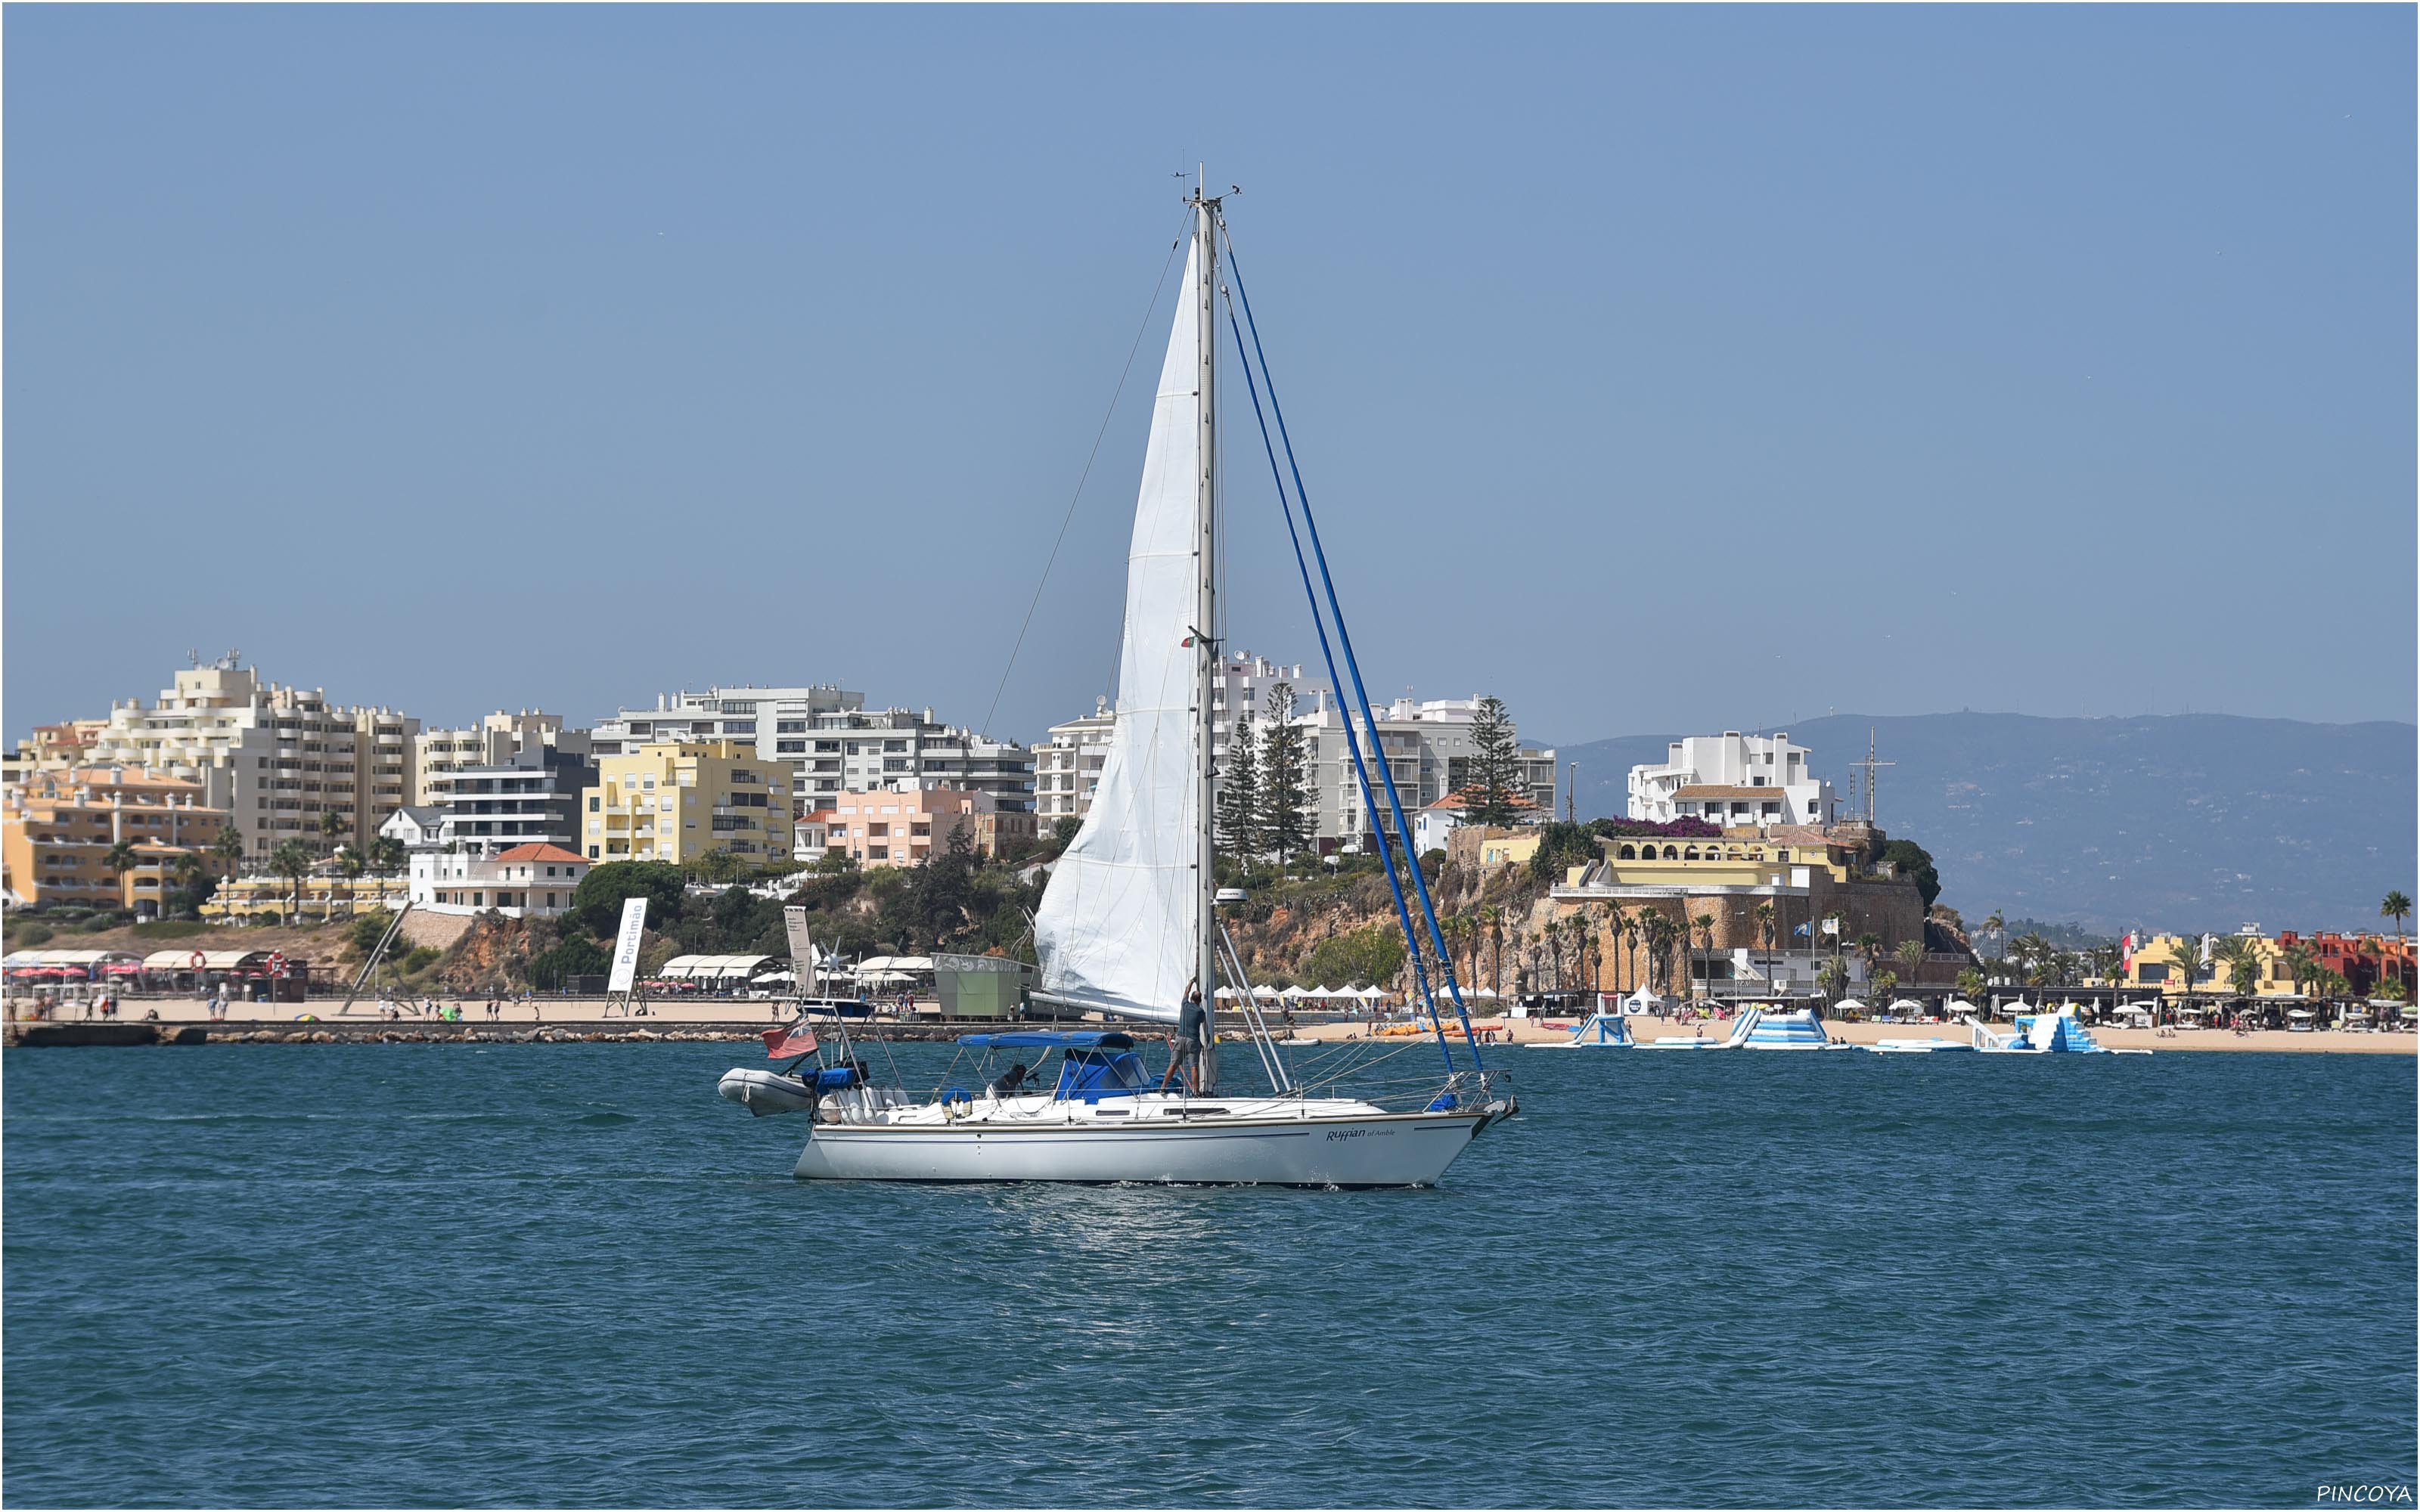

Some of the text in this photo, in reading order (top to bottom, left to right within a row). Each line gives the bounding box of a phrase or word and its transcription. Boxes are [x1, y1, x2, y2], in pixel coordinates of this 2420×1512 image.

[620, 905, 642, 964] Portimão
[1326, 1127, 1366, 1142] Ruffian
[1376, 1129, 1395, 1137] Amble
